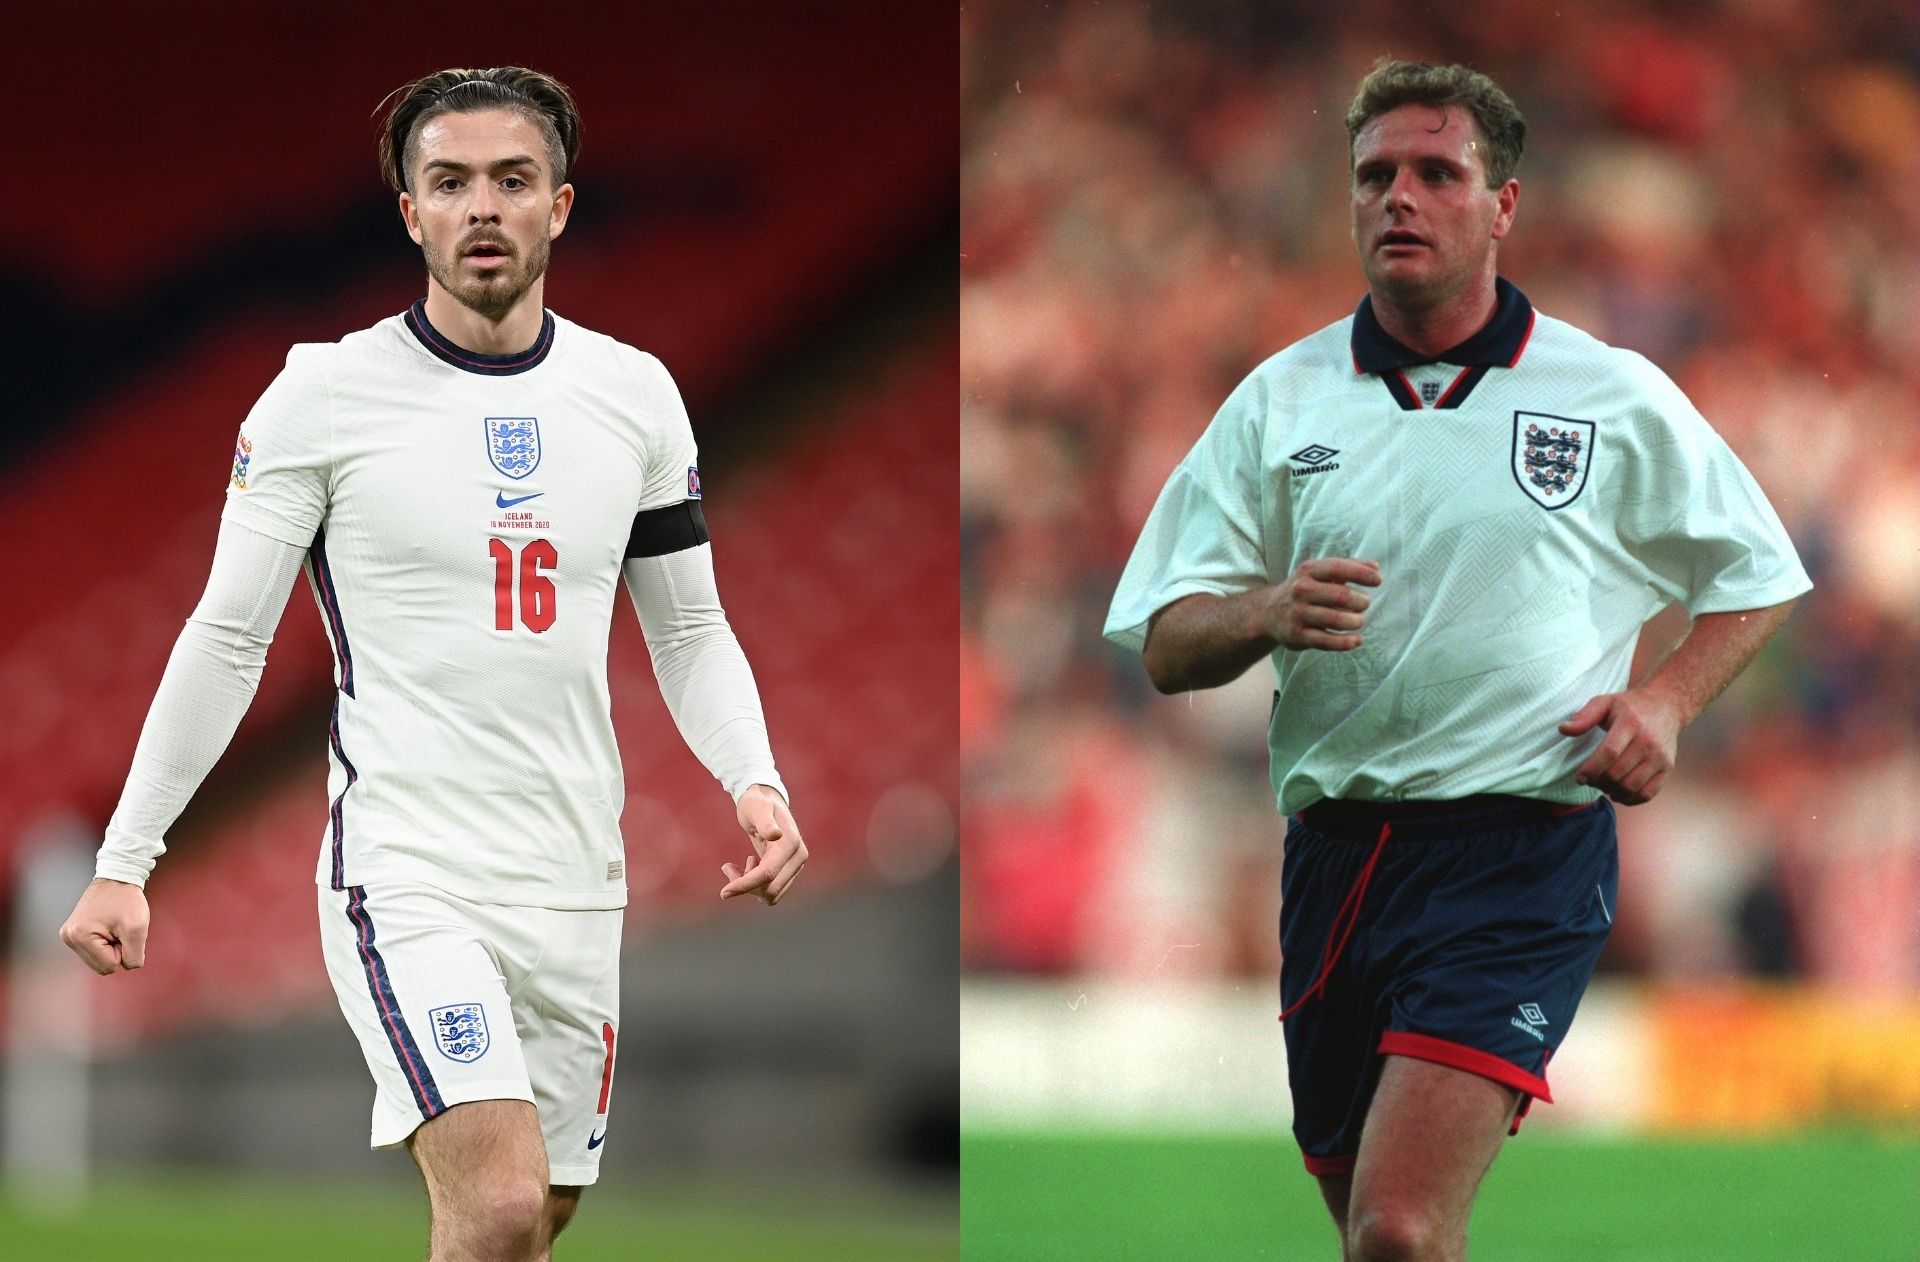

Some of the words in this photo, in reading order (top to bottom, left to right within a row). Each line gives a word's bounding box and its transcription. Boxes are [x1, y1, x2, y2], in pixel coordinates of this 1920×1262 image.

[1292, 461, 1340, 477] UMBRO
[504, 512, 533, 520] ICELAND
[498, 521, 533, 529] NOVEMBER
[535, 521, 550, 529] 2020
[489, 538, 558, 634] 16
[1511, 1016, 1545, 1042] UMBRO
